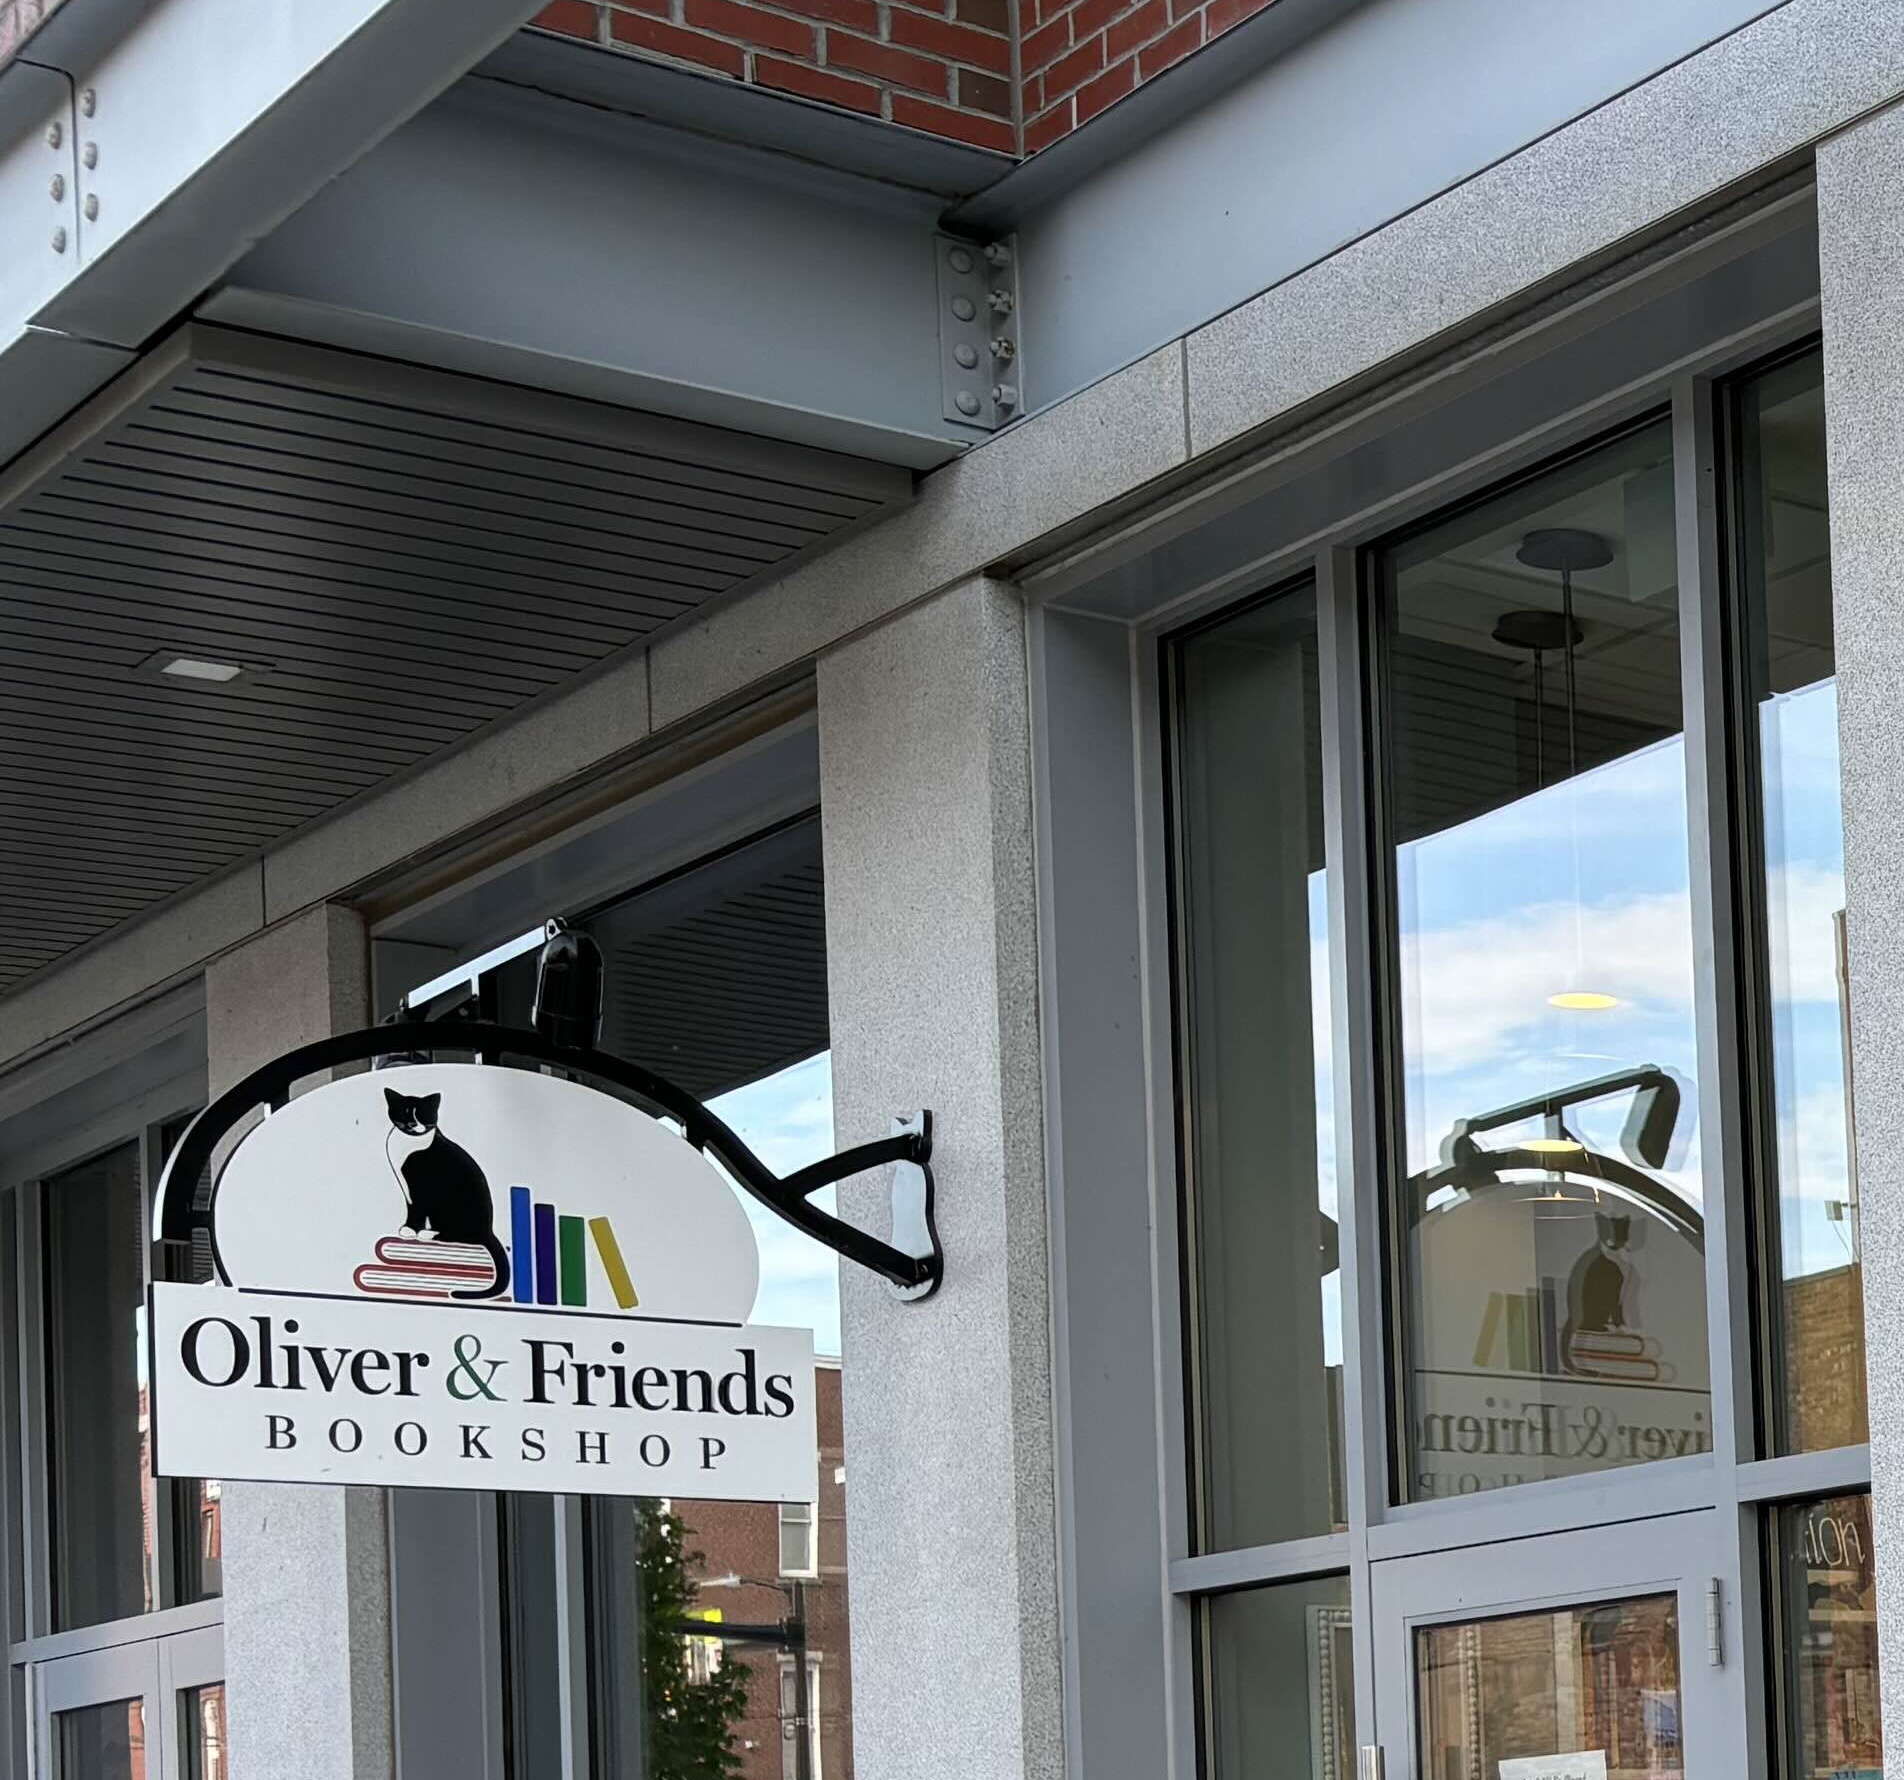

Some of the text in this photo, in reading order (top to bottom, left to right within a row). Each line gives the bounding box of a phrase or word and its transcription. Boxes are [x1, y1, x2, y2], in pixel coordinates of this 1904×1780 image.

[180, 1316, 794, 1418] Oliver & Friends
[265, 1414, 727, 1470] BOOKSHOP
